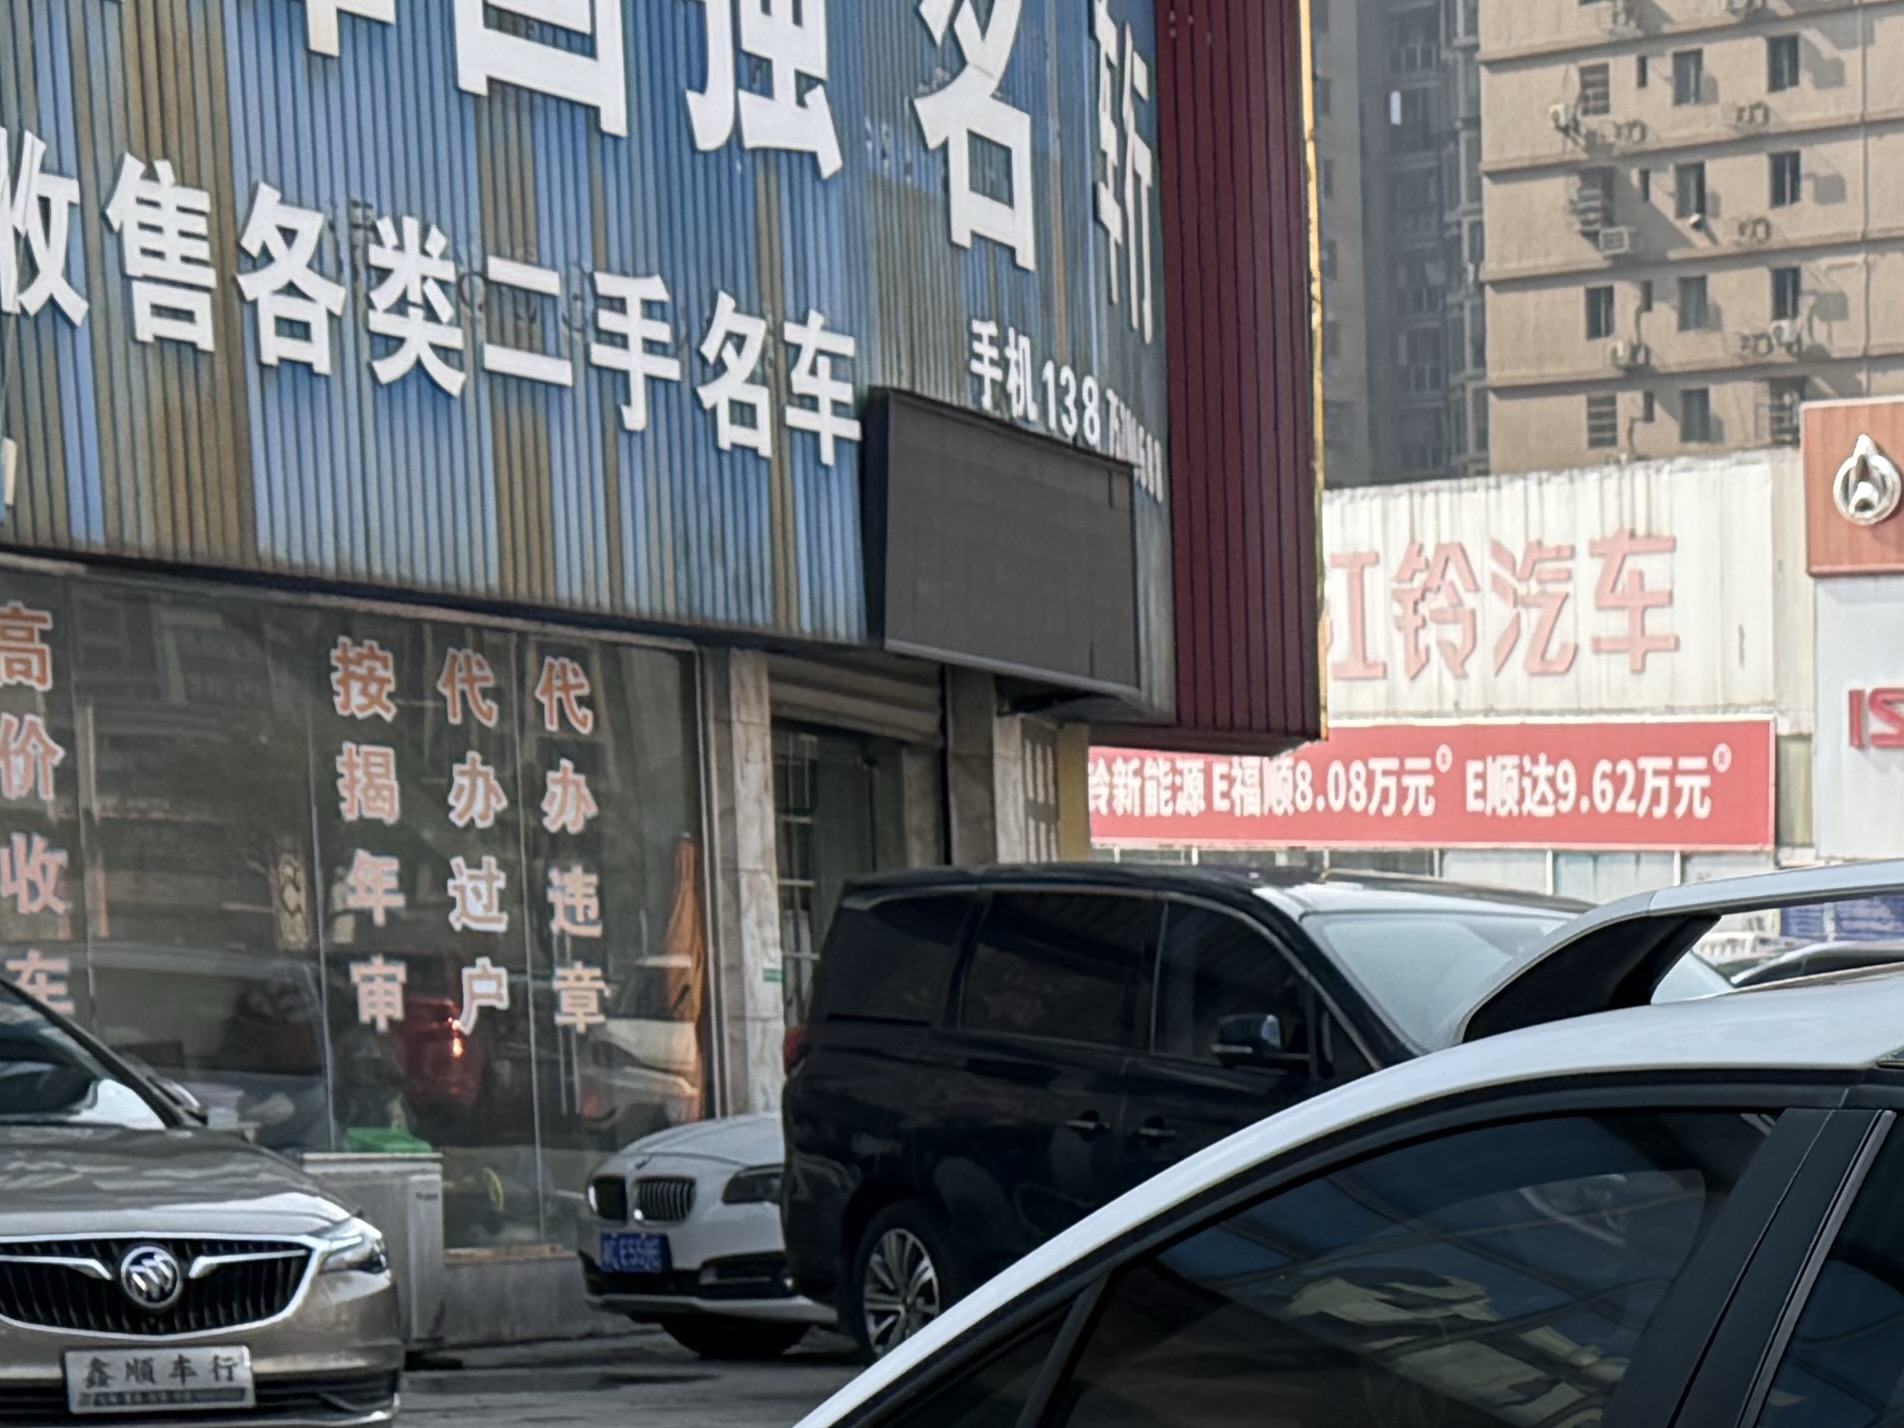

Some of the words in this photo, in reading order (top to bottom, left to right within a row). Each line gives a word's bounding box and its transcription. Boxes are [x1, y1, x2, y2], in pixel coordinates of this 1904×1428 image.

[0, 125, 861, 467] 收售各类二手名车
[330, 636, 408, 1034] 按揭年审
[437, 647, 510, 1035] 代办过户
[535, 655, 608, 1035] 代办违章
